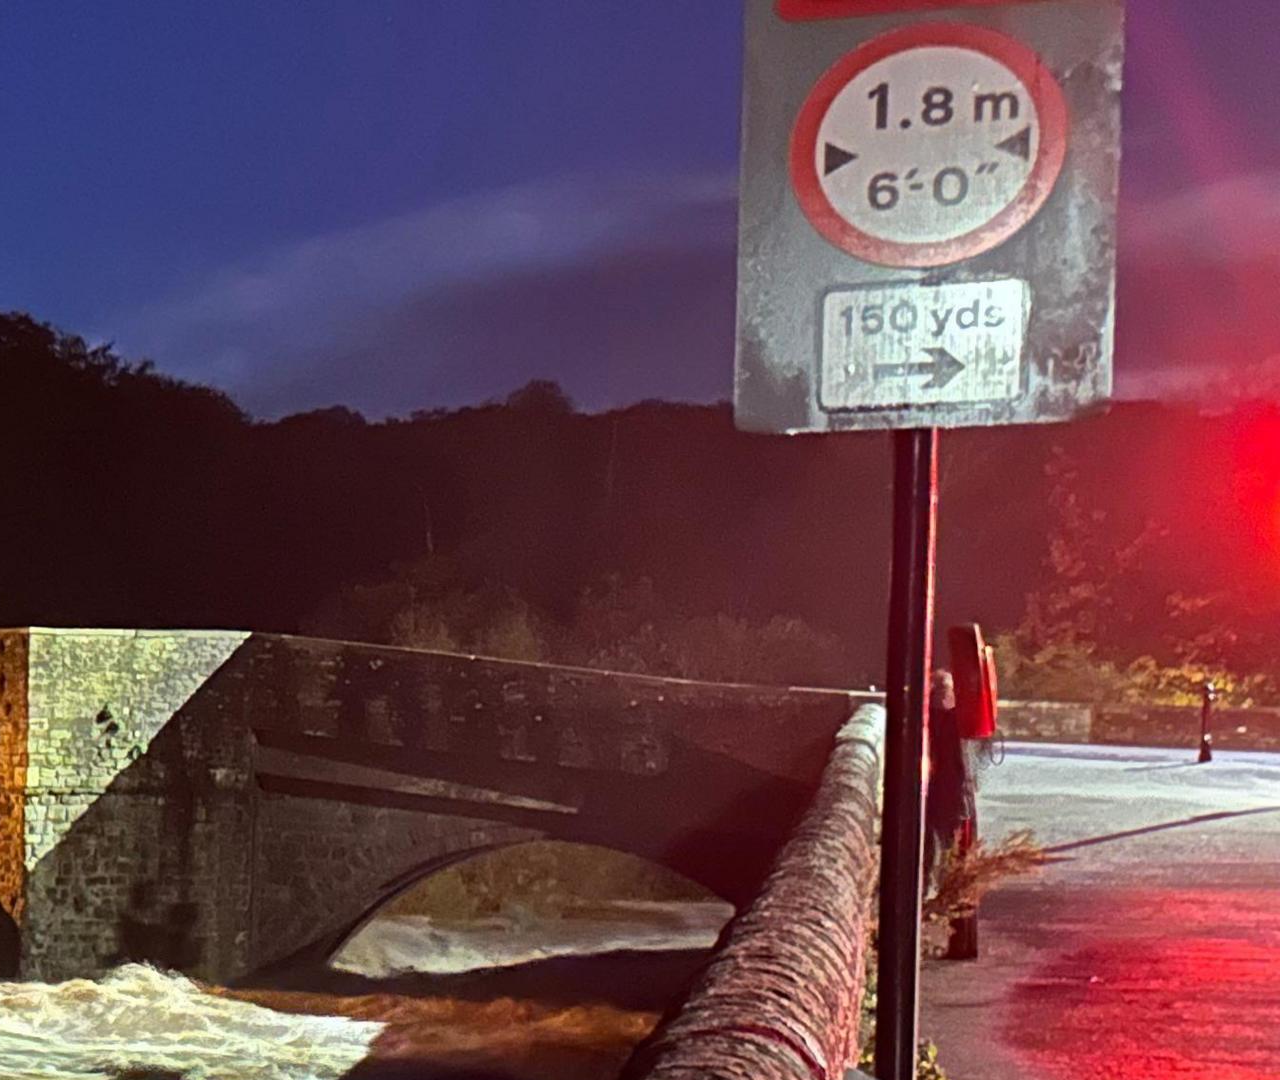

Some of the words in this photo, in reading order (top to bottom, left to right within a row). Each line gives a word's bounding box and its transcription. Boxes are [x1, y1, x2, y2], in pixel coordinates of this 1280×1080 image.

[868, 82, 954, 130] 1.8
[973, 91, 1019, 123] m
[841, 300, 918, 336] 150
[930, 299, 1006, 337] yds
